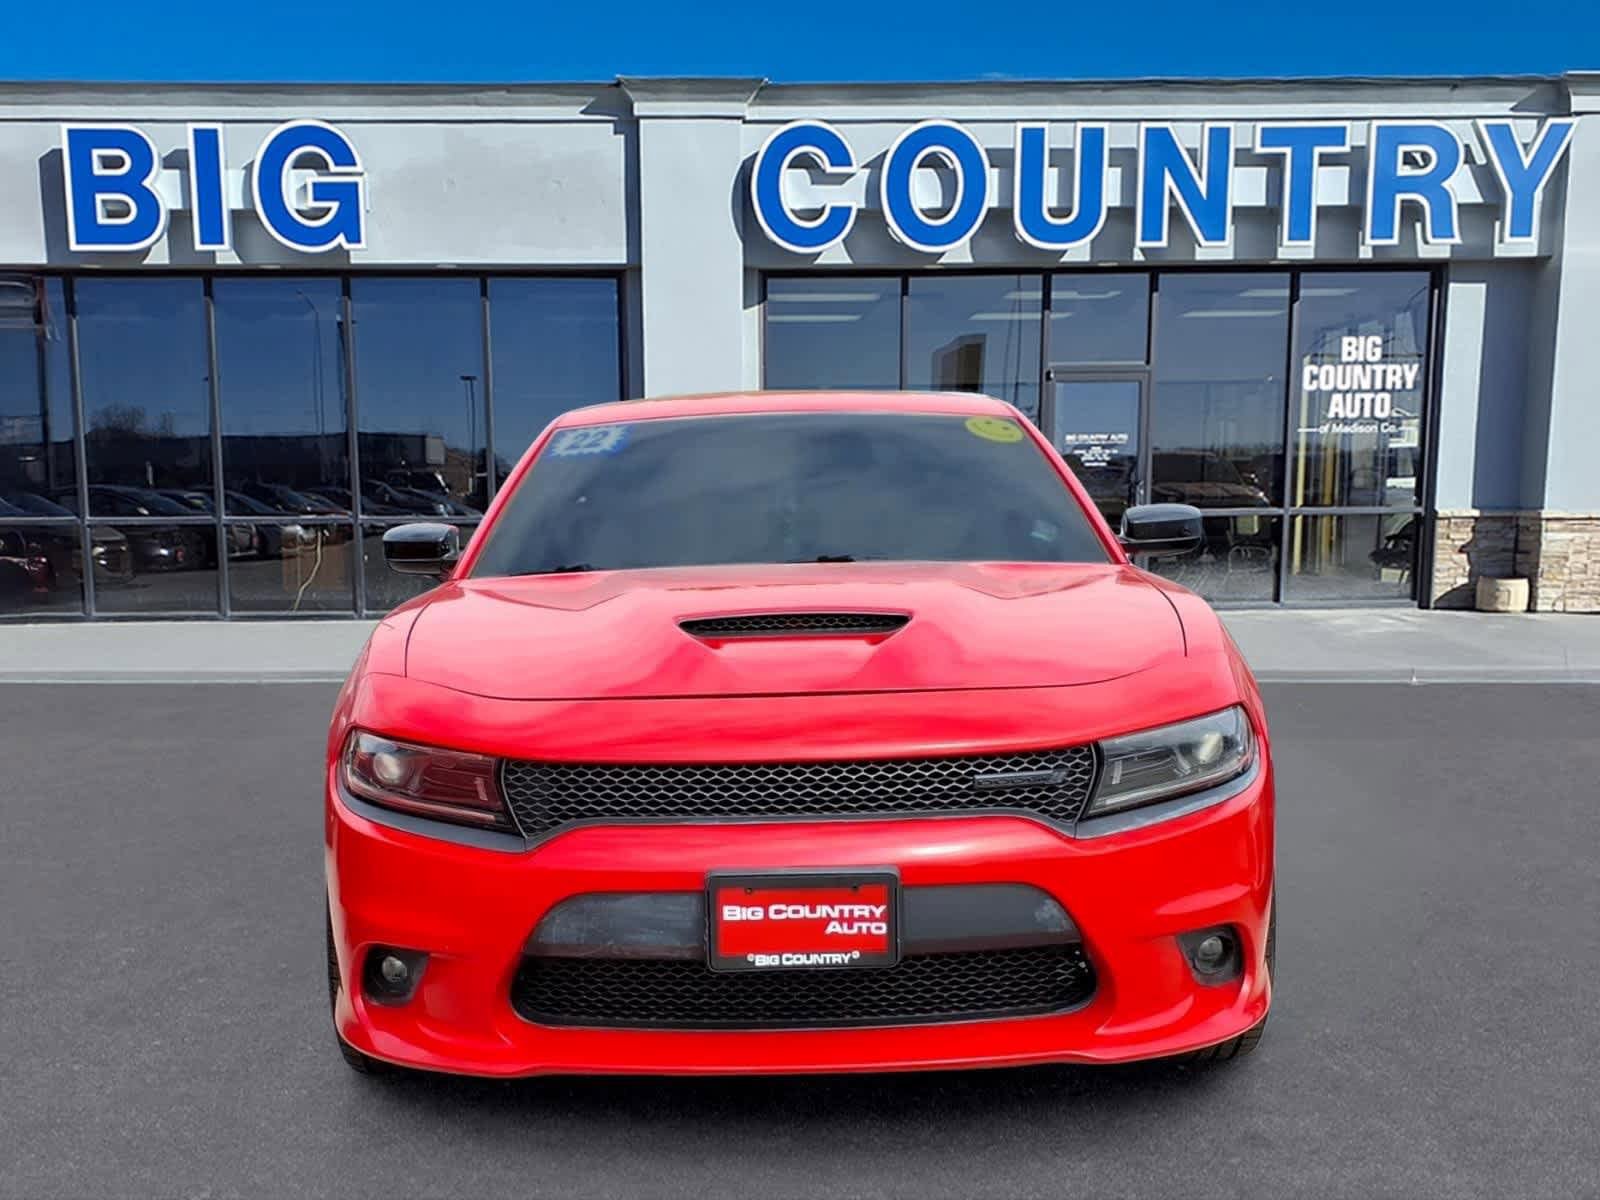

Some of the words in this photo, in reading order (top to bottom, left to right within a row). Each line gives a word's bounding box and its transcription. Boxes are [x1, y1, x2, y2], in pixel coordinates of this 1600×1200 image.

[60, 119, 367, 253] BIG
[751, 115, 1577, 254] COUNTRY
[1341, 335, 1382, 362] BIG
[1302, 364, 1419, 391] COUNTRY
[1327, 392, 1391, 419] AUTO
[722, 904, 764, 921] BIG
[768, 903, 887, 920] COUNTRY
[824, 920, 888, 935] AUTO
